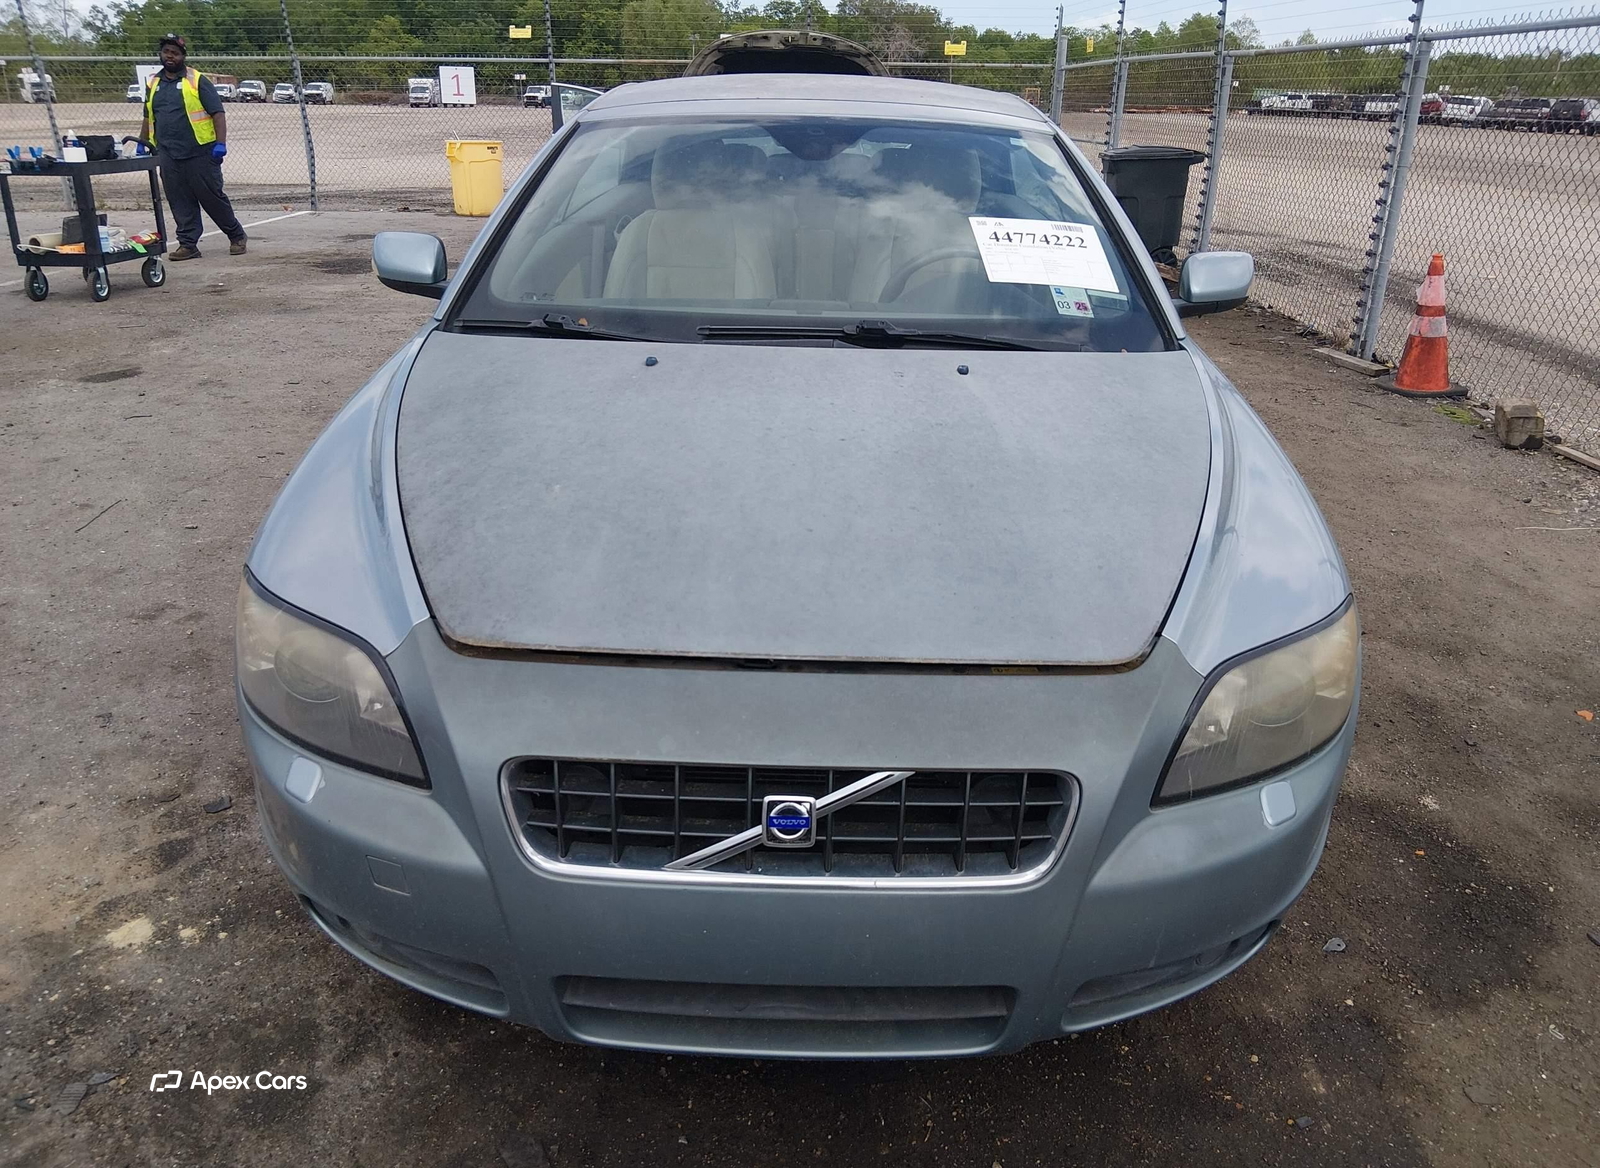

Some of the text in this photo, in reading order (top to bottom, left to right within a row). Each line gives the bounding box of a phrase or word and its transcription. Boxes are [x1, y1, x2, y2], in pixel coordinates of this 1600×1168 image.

[451, 73, 465, 97] 1
[988, 230, 1088, 249] 44774222
[1057, 300, 1088, 311] 03 25
[772, 818, 807, 826] VOLVO
